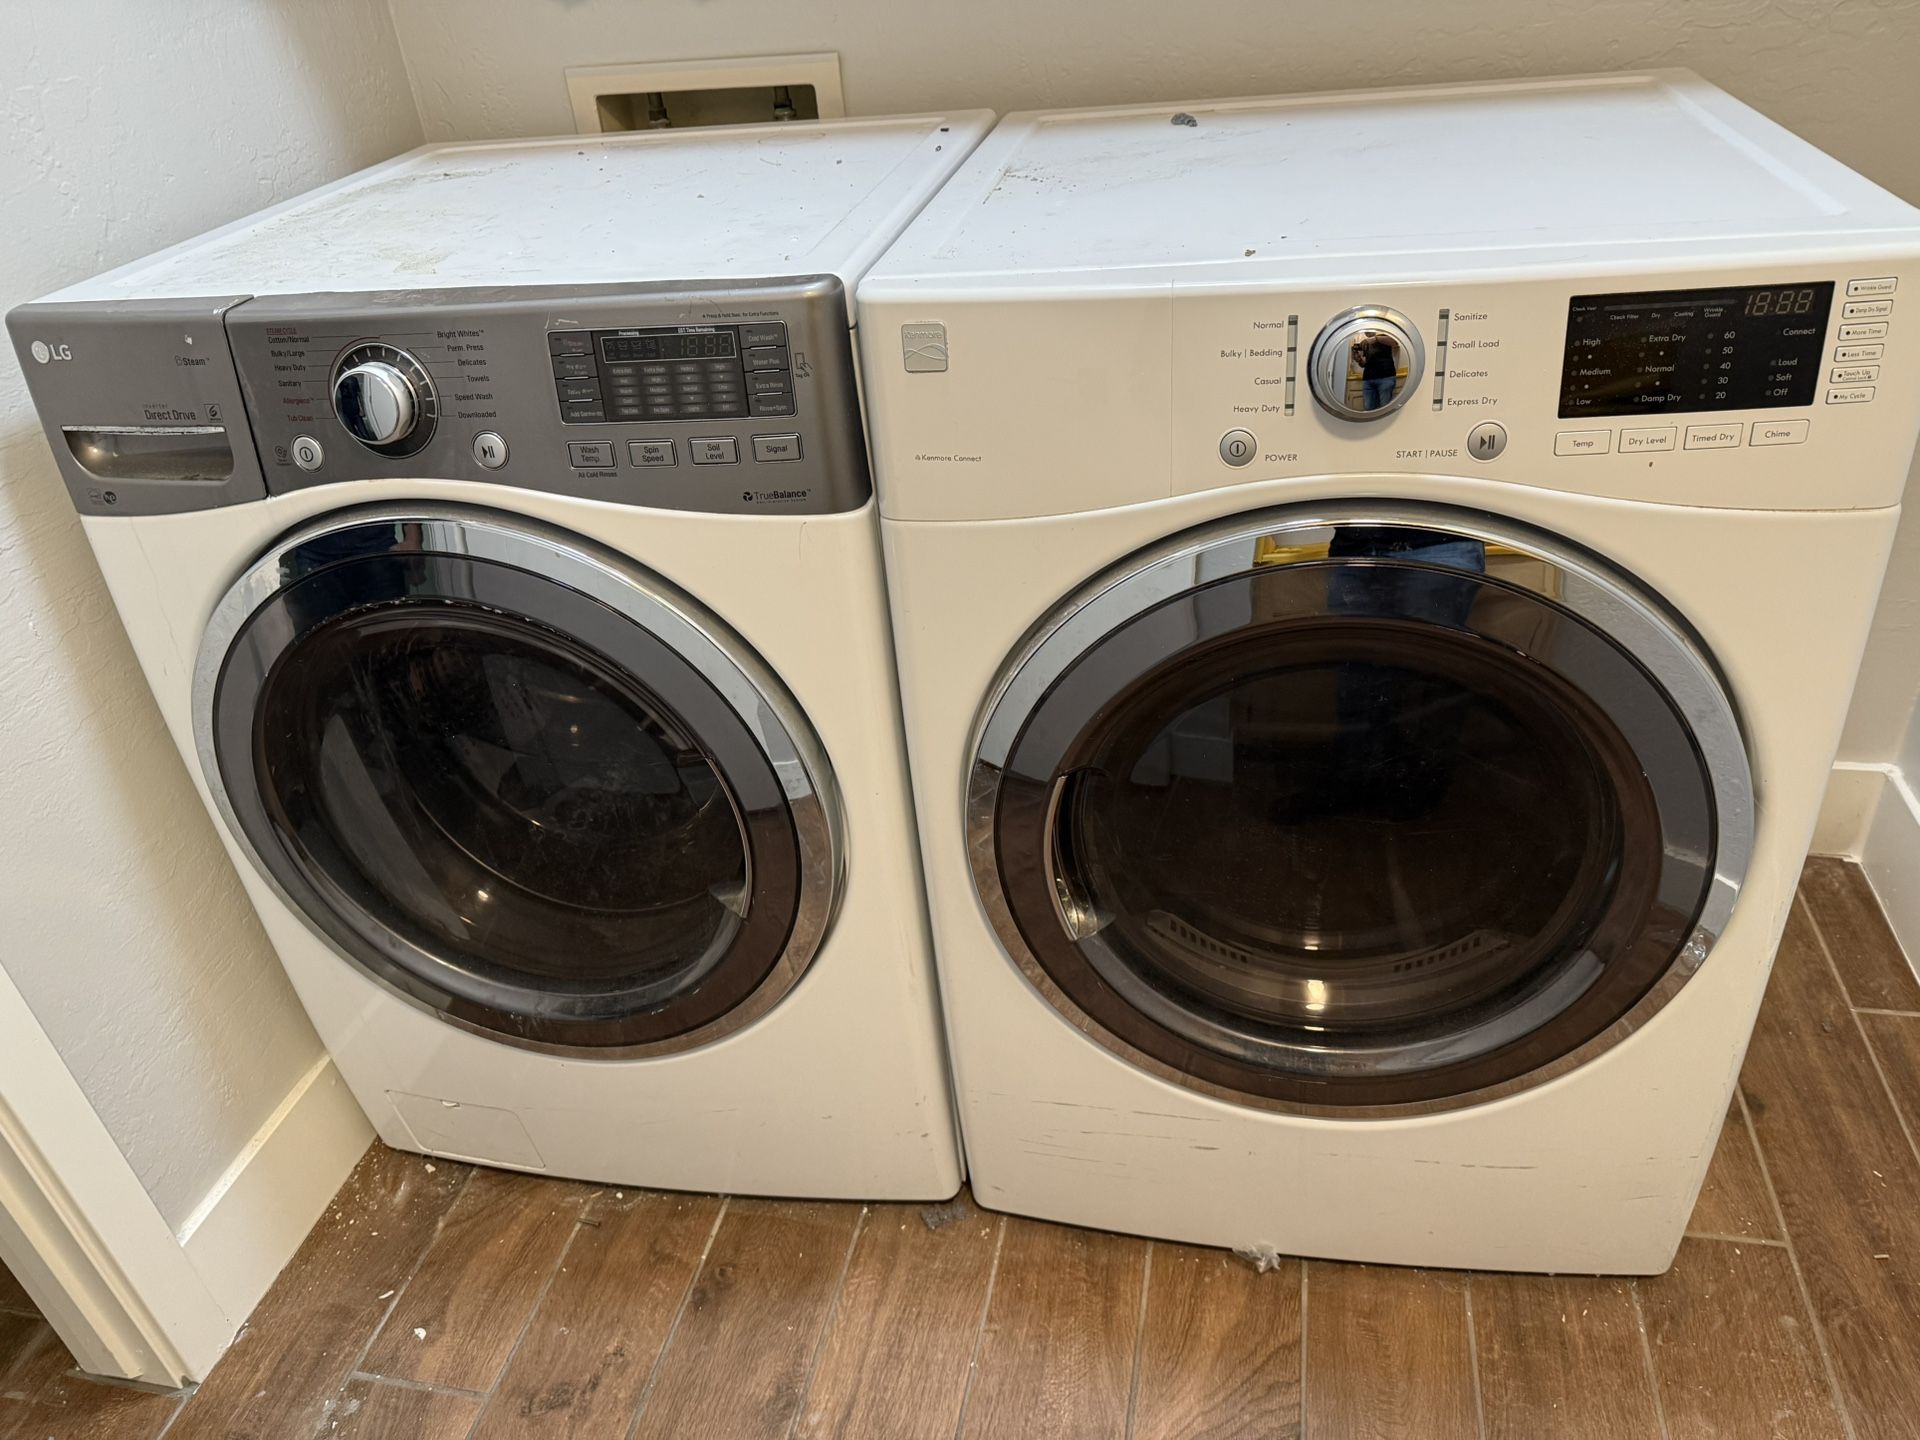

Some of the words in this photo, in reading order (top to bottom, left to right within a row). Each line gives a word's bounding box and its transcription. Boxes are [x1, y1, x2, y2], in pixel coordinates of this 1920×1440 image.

[1454, 312, 1488, 321] Sanitize
[1253, 320, 1284, 330] Normal
[437, 330, 457, 340] Bright
[1724, 331, 1736, 339] 60
[1782, 327, 1816, 336] Connect
[1582, 338, 1601, 348] High
[1649, 335, 1670, 343] Extra
[1671, 334, 1687, 343] Dry
[1451, 340, 1476, 349] Small
[1478, 339, 1500, 348] Load
[49, 343, 72, 361] LG
[1220, 349, 1242, 359] Bulky
[1250, 348, 1283, 359] Bedding
[1722, 346, 1734, 354] 50
[457, 359, 487, 367] Delicates
[1720, 361, 1732, 369] 40
[1778, 357, 1798, 366] Loud
[1579, 368, 1611, 377] Medium
[1645, 364, 1675, 373] Normal
[1450, 369, 1488, 378] Delicates
[1775, 373, 1793, 382] Soft
[466, 375, 490, 383] Towels
[1254, 377, 1282, 386] Casual
[1717, 376, 1729, 384] 30
[1715, 391, 1727, 399] 20
[1773, 387, 1789, 396] Off
[454, 393, 474, 402] Speed
[474, 393, 494, 401] Wash
[1447, 398, 1479, 408] Express
[1481, 396, 1498, 406] Dry
[1576, 397, 1592, 406] Low
[1641, 394, 1665, 404] Damp
[1667, 393, 1682, 402] Dry
[1233, 404, 1259, 414] Heavy
[1261, 404, 1281, 414] Duty
[144, 409, 172, 421] Direct
[172, 409, 197, 421] Drive
[1692, 433, 1717, 443] Timed
[1719, 432, 1735, 442] Dry
[1765, 429, 1791, 439] Chime
[1572, 440, 1594, 449] Temp
[1629, 437, 1644, 446] Dry
[1646, 435, 1667, 445] Level
[580, 446, 600, 454] Wash
[643, 446, 660, 455] Spin
[707, 443, 721, 452] Soil
[765, 444, 788, 454] Signal
[705, 452, 725, 460] Level
[921, 454, 952, 462] Kenmore
[953, 454, 982, 462] Connect
[1265, 454, 1298, 462] POWER
[1396, 450, 1423, 459] START
[1430, 449, 1458, 458] PAUSE
[642, 454, 665, 464] Speed
[753, 489, 807, 500] TrueBalance
